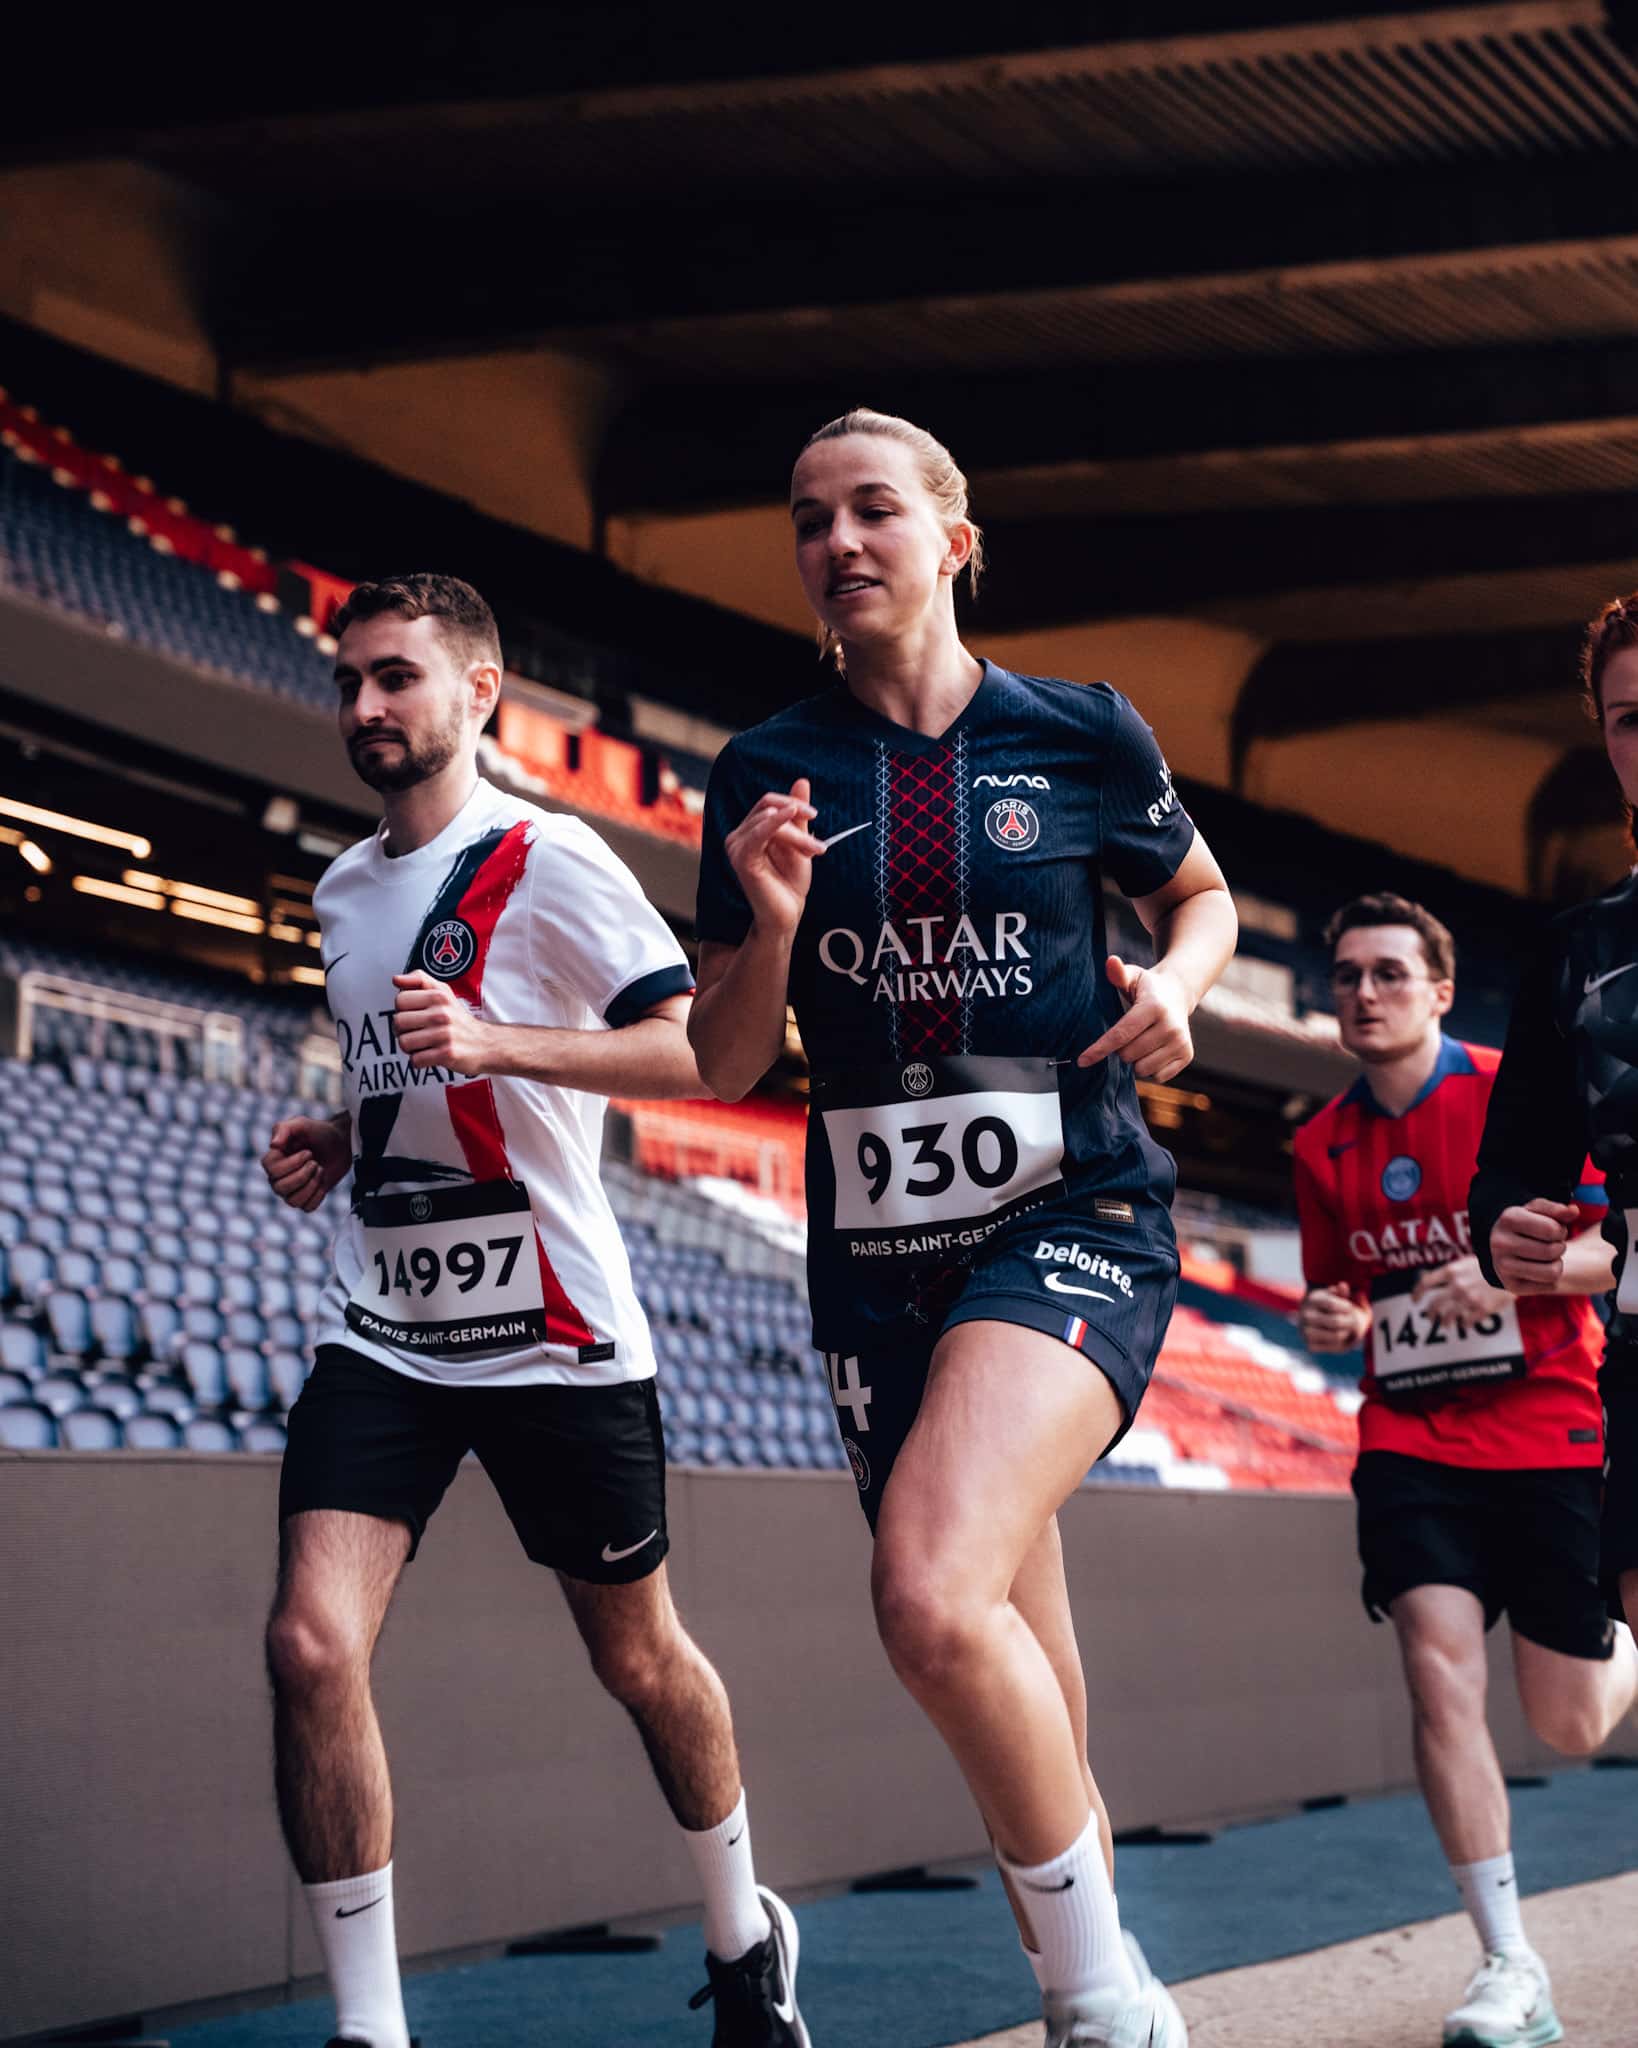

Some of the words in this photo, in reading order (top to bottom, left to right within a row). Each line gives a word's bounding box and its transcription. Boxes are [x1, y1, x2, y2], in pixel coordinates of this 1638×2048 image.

[972, 774, 1051, 790] nuna
[993, 801, 1030, 816] PARIS
[432, 923, 464, 938] PARIS
[818, 912, 1033, 986] QATAR
[873, 964, 1034, 1003] AIRWAYS
[336, 1010, 397, 1073] QAT
[358, 1059, 477, 1093] AIRWA
[857, 1115, 1018, 1205] 930
[374, 1235, 524, 1298] 14997
[851, 1240, 893, 1257] PARIS
[1033, 1240, 1134, 1298] Deloitte.
[360, 1313, 409, 1344] PARIS
[409, 1320, 526, 1345] SAINT-GERMAIN
